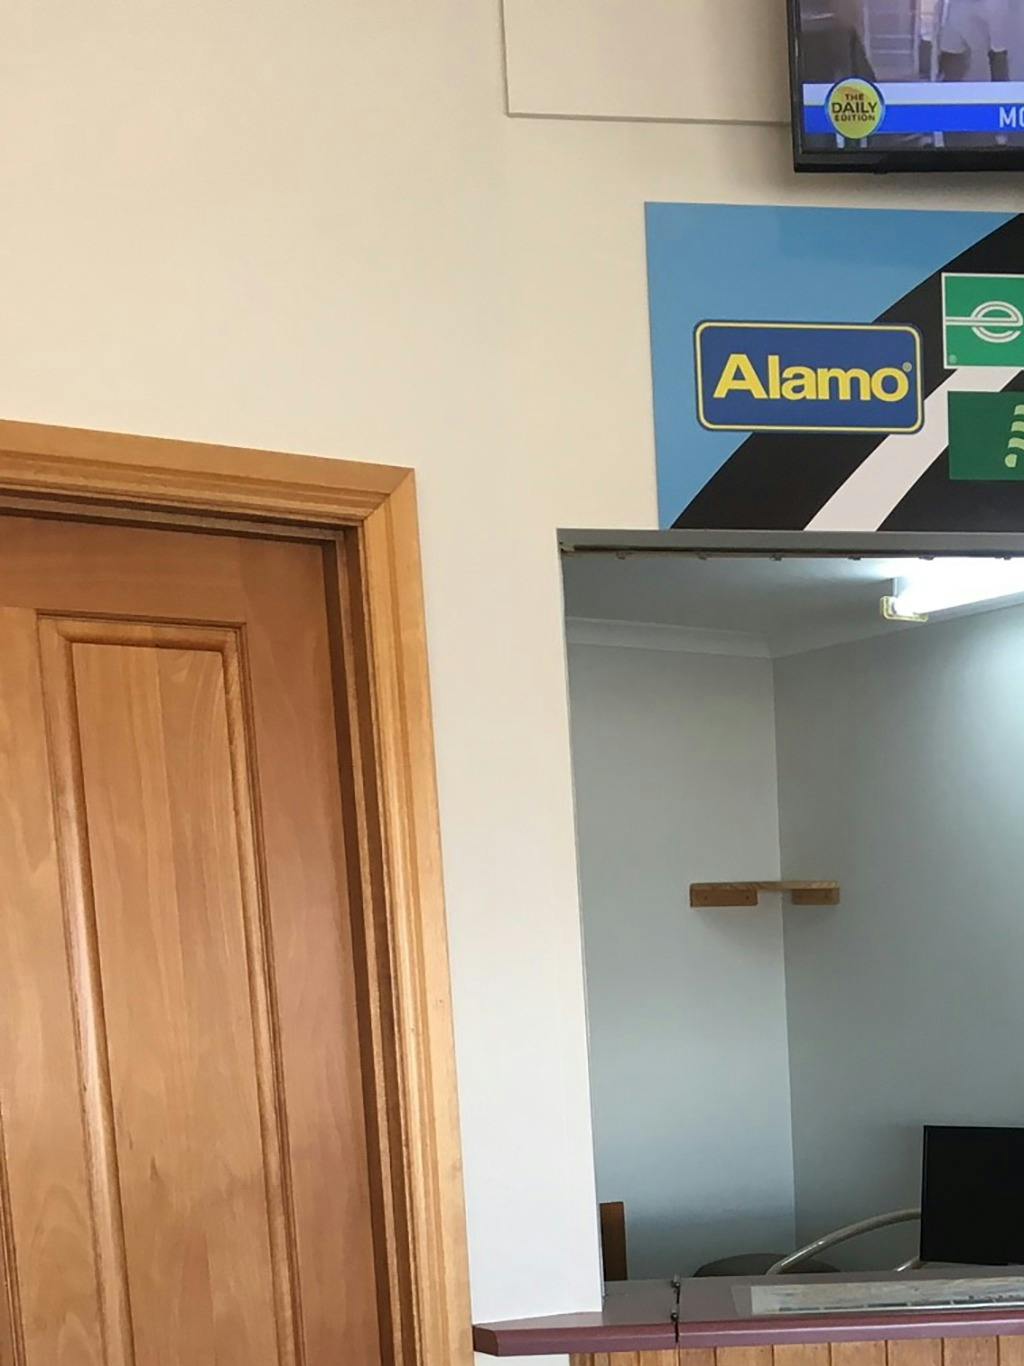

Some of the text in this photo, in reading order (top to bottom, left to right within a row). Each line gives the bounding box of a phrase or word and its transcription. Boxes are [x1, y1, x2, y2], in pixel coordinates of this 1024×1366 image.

[844, 93, 864, 101] THE
[832, 102, 878, 114] DAILY
[834, 113, 876, 122] EDITION
[713, 353, 909, 402] Alamo
